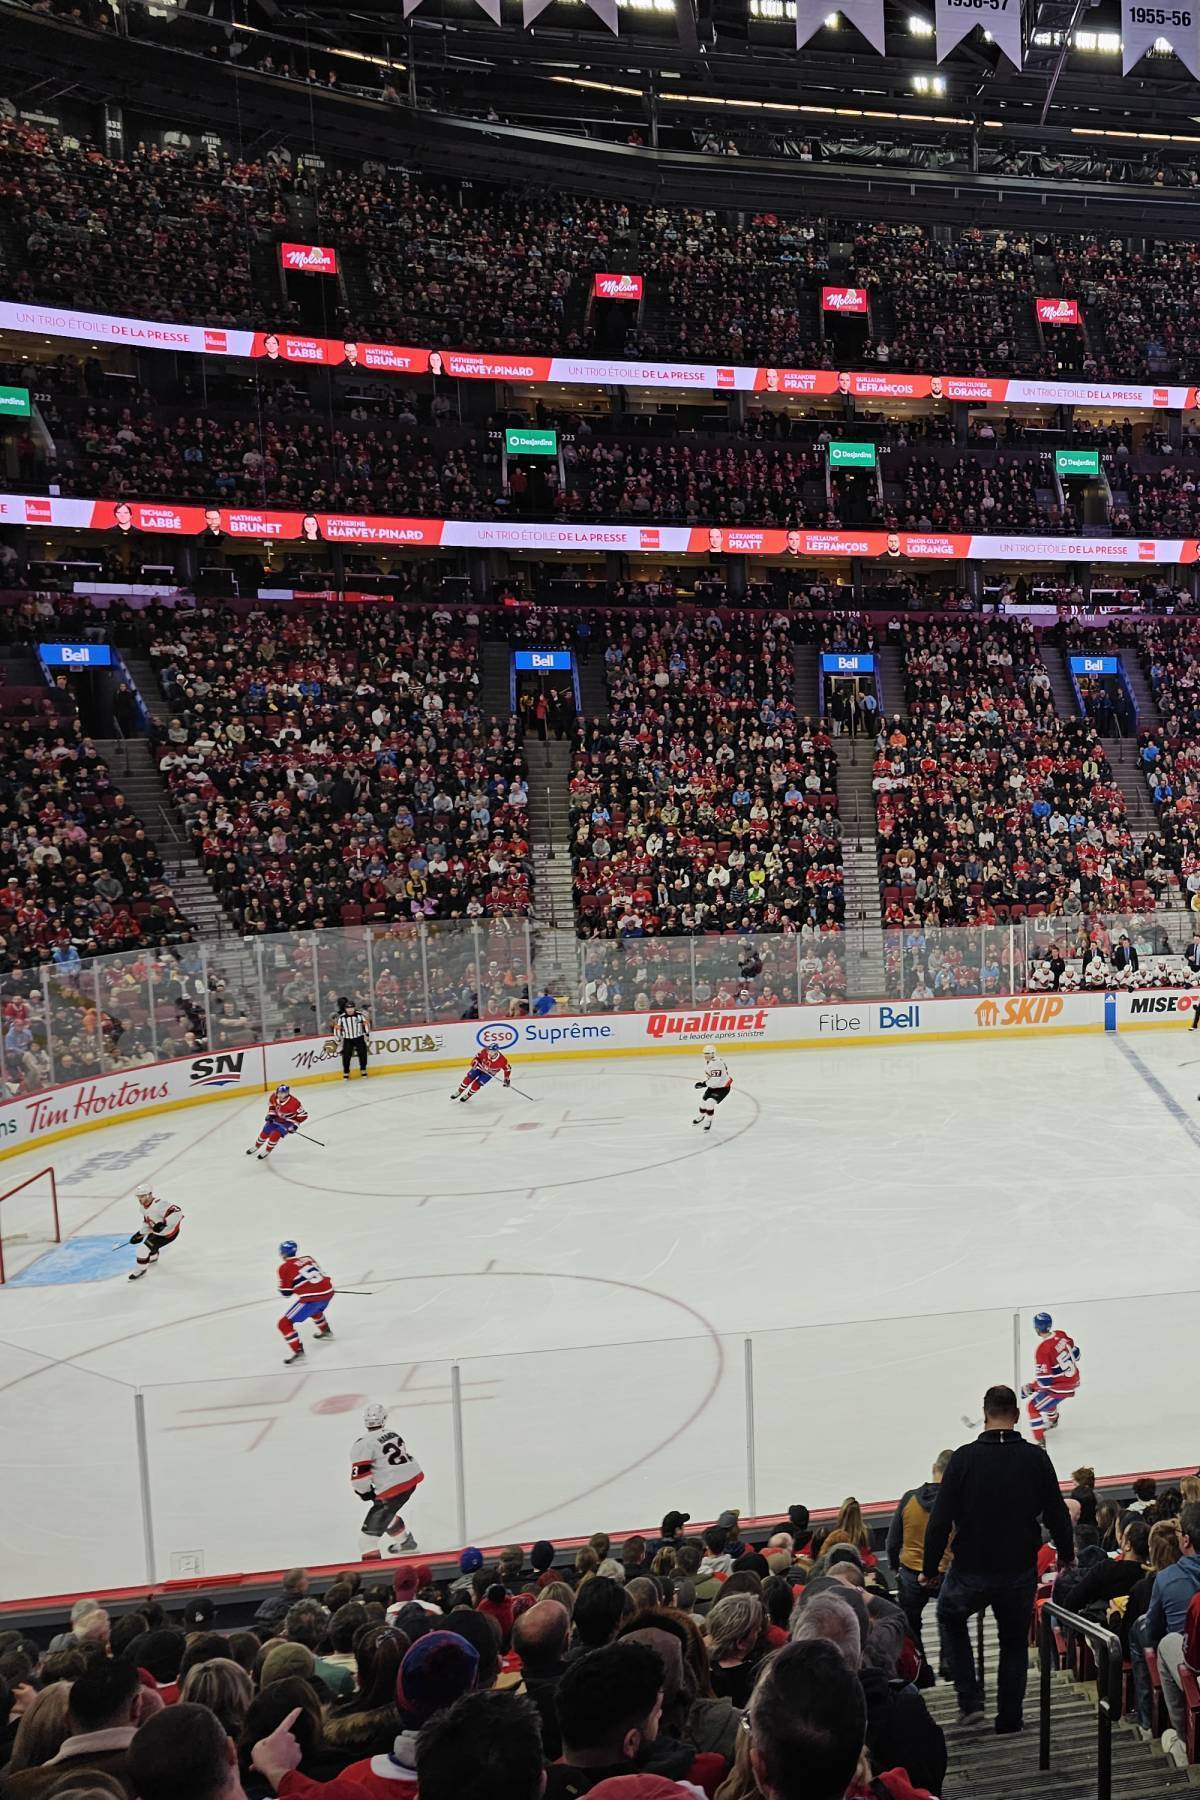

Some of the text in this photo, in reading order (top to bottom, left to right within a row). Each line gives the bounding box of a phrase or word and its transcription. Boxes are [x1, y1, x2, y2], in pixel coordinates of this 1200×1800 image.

[1129, 7, 1192, 27] 1955-56
[286, 247, 331, 269] Molson
[598, 277, 640, 297] Molson
[826, 291, 863, 308] Molson
[1041, 303, 1073, 320] Molson
[16, 312, 36, 323] UN
[38, 314, 66, 327] TRIO
[68, 315, 109, 333] ÉTOILE
[111, 325, 129, 336] DE
[130, 327, 147, 338] LA
[148, 330, 190, 343] PRESSE
[287, 346, 324, 361] LABBÉ
[365, 354, 411, 370] BRUNET
[450, 363, 534, 378] HARVEY-PINARD
[568, 366, 705, 381] UN TRIO ÉTOILE DE LA PRESSE
[784, 380, 816, 390] PRATT
[856, 382, 913, 396] LEFRANÇOIS
[33, 393, 51, 401] 222
[948, 387, 993, 398] LORANGE
[1112, 391, 1143, 401] PRESSE
[520, 437, 553, 448] Desjardins
[842, 450, 873, 460] Desjardins
[1067, 457, 1096, 467] Desjardins
[140, 508, 174, 518] RICHARD
[229, 514, 262, 523] MATHIAS
[140, 515, 182, 529] LABBÉ
[230, 521, 282, 534] BRUNET
[327, 519, 366, 528] KATHERINE
[327, 526, 424, 541] HARVEY-PINARD
[478, 530, 627, 543] UN TRIO ÉTOILE DE LA PRESSE
[728, 540, 762, 550] PRATT
[806, 541, 869, 555] LEFRANÇOIS
[907, 544, 955, 555] LORANGE
[1095, 545, 1128, 555] PRESSE
[61, 648, 90, 662] Bell
[532, 654, 554, 667] Bell
[838, 656, 858, 669] Bell
[1085, 658, 1104, 671] Bell
[880, 1005, 920, 1029] Bell
[1001, 996, 1064, 1026] SKIP
[646, 1009, 769, 1039] Qualinet
[819, 1013, 861, 1033] Fibe
[483, 1030, 513, 1042] Esso
[525, 1023, 611, 1044] Suprême
[690, 1032, 713, 1040] leader
[737, 1030, 765, 1038] sinistre
[292, 1045, 341, 1070] Molso
[190, 1052, 245, 1081] SN
[25, 1096, 68, 1134] Tim
[73, 1080, 169, 1118] Hortons
